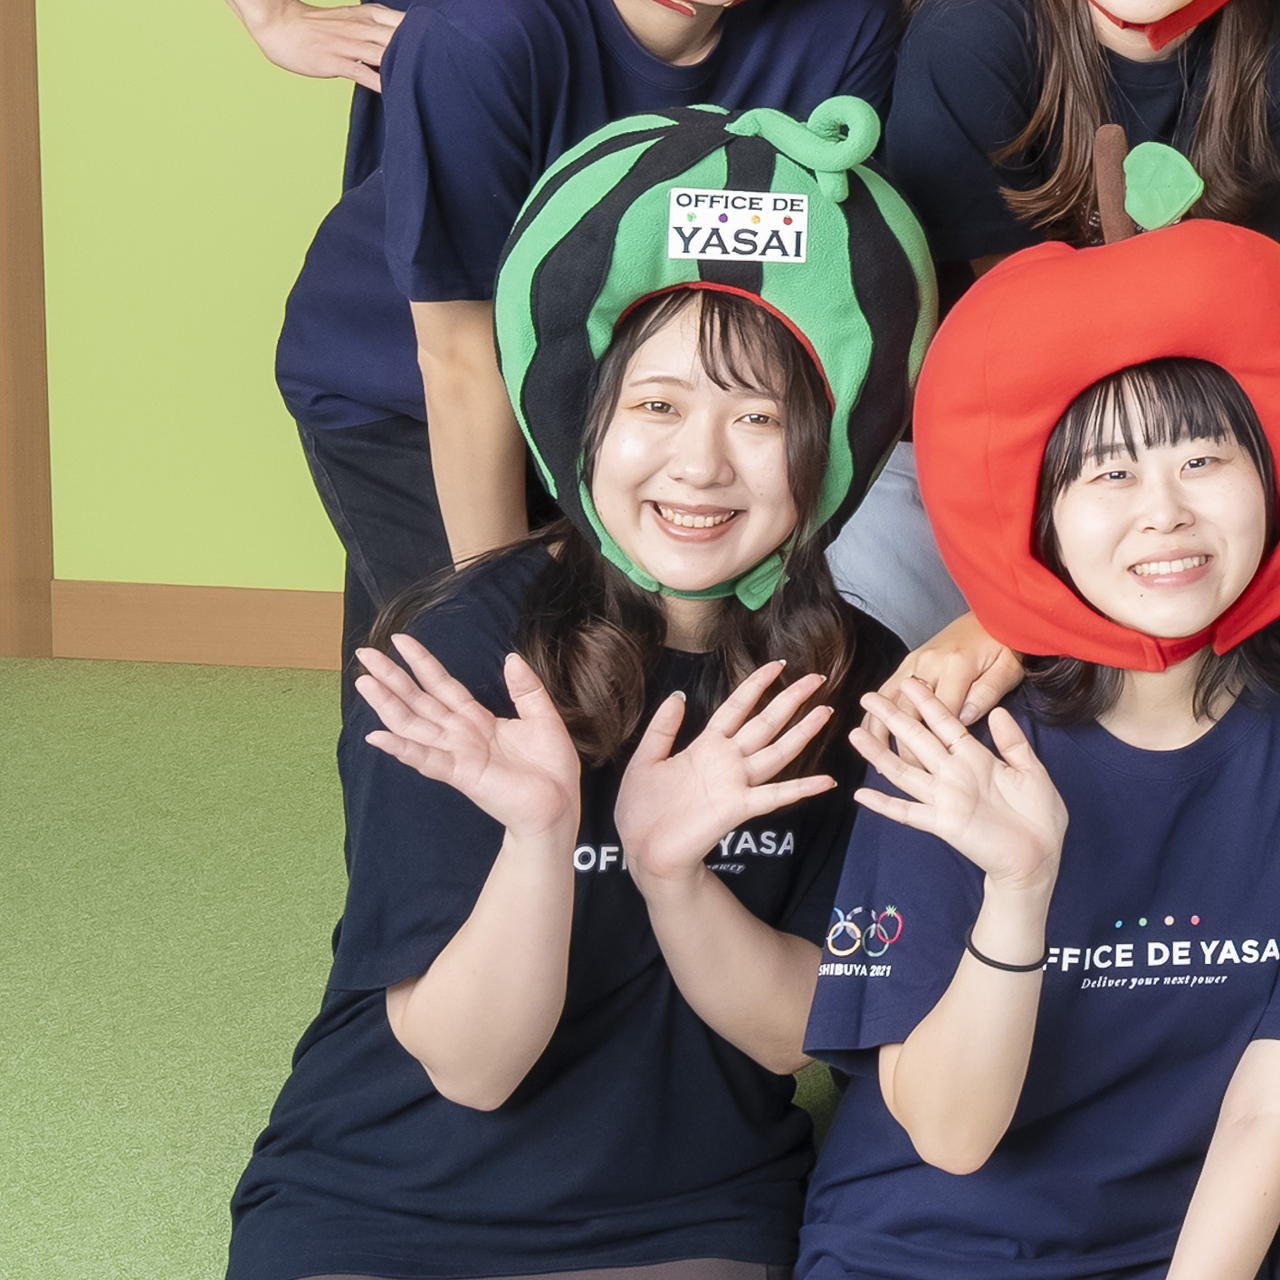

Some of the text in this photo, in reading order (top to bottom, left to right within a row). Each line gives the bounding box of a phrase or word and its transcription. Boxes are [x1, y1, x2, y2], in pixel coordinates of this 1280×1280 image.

[676, 193, 804, 212] OFFICE DE
[673, 227, 803, 257] YASAI
[718, 831, 794, 857] YASA
[706, 863, 746, 875] ower
[1042, 938, 1280, 971] FFICE DE YASA
[818, 963, 891, 977] SHIBUYA 2021
[1080, 974, 1228, 989] Deliver your next power
